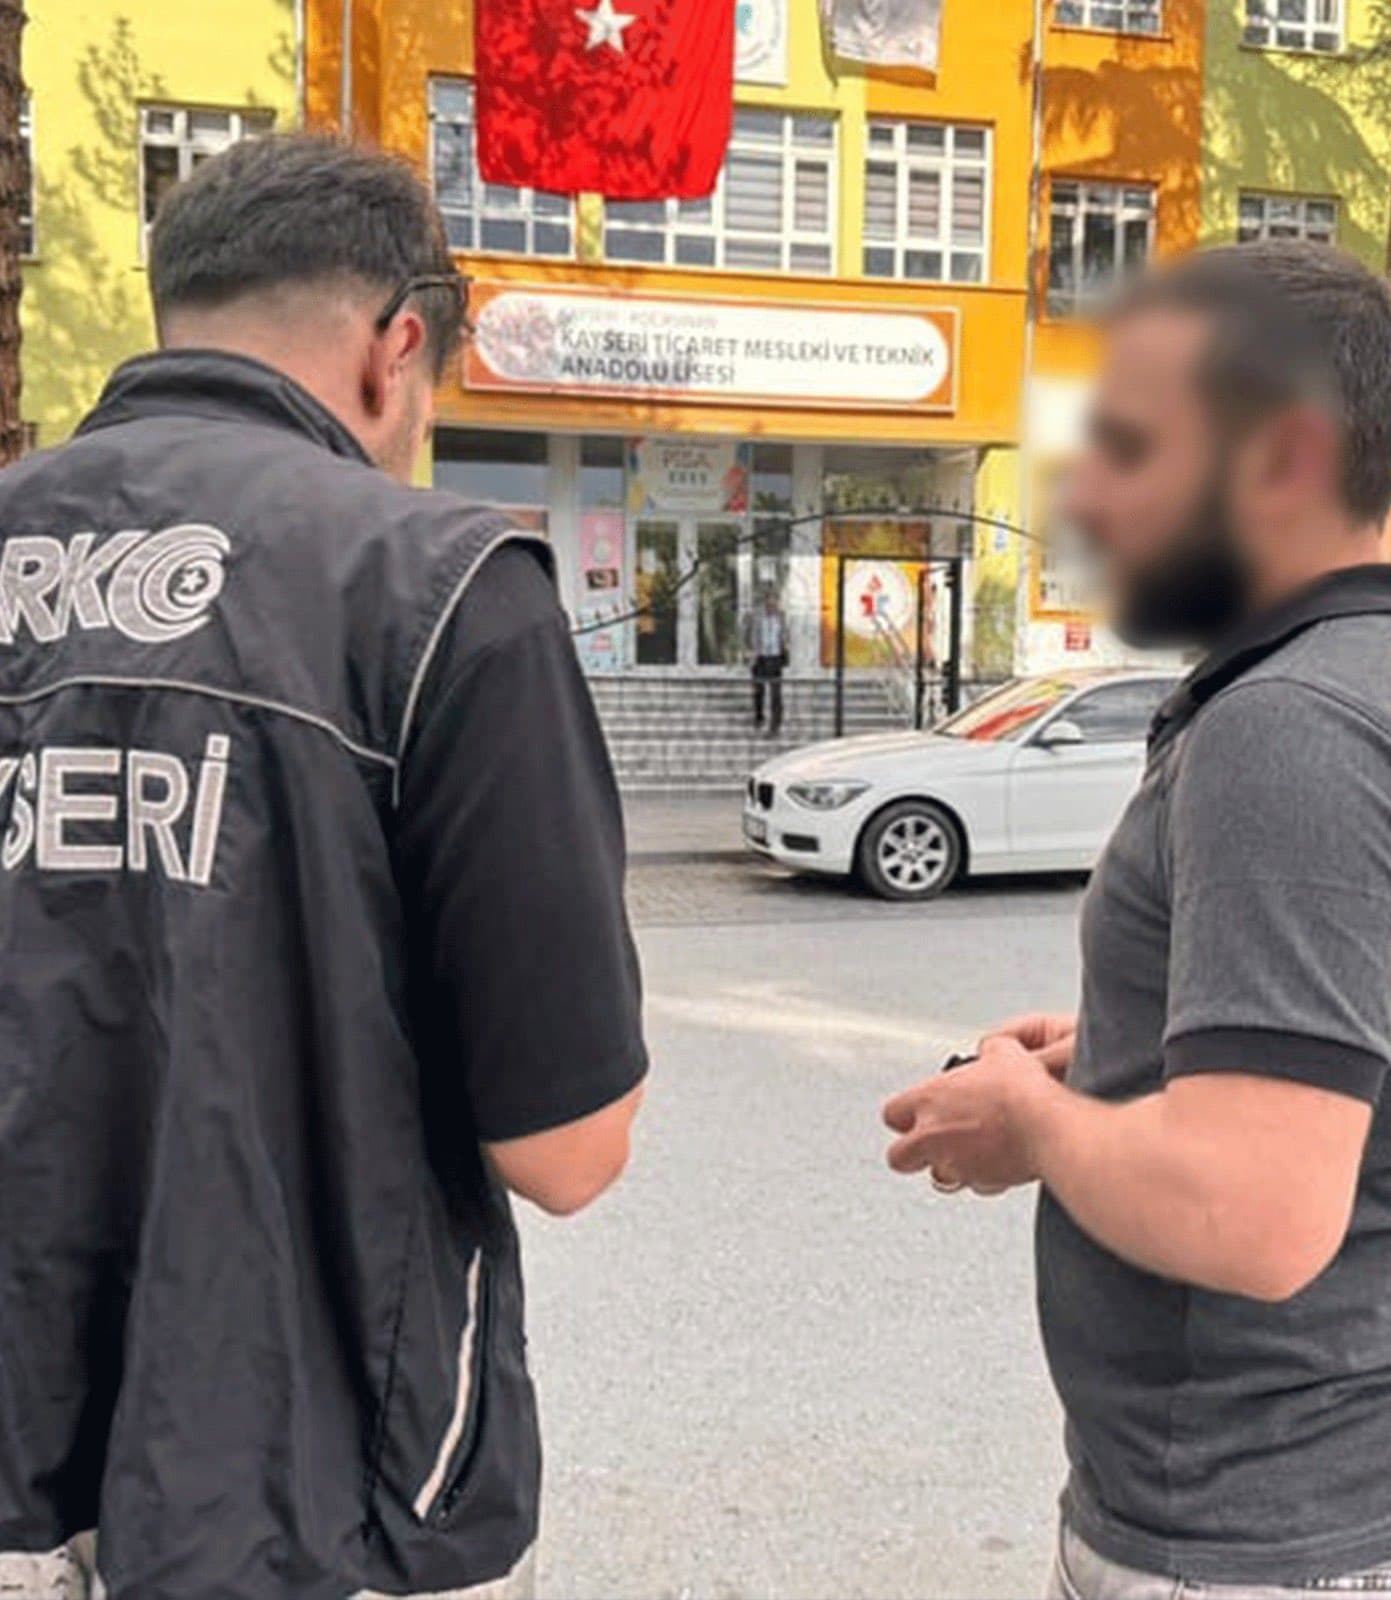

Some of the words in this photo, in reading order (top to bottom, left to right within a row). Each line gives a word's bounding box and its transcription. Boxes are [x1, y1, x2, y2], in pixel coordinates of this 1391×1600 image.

[561, 328, 648, 354] KAYSERİ
[653, 330, 739, 358] TİCARET
[744, 337, 831, 364] MESLEKİ
[833, 343, 859, 365] VE
[864, 343, 935, 367] TEKNİK
[561, 355, 669, 383] ANADOLU
[673, 358, 737, 386] LİSESİ
